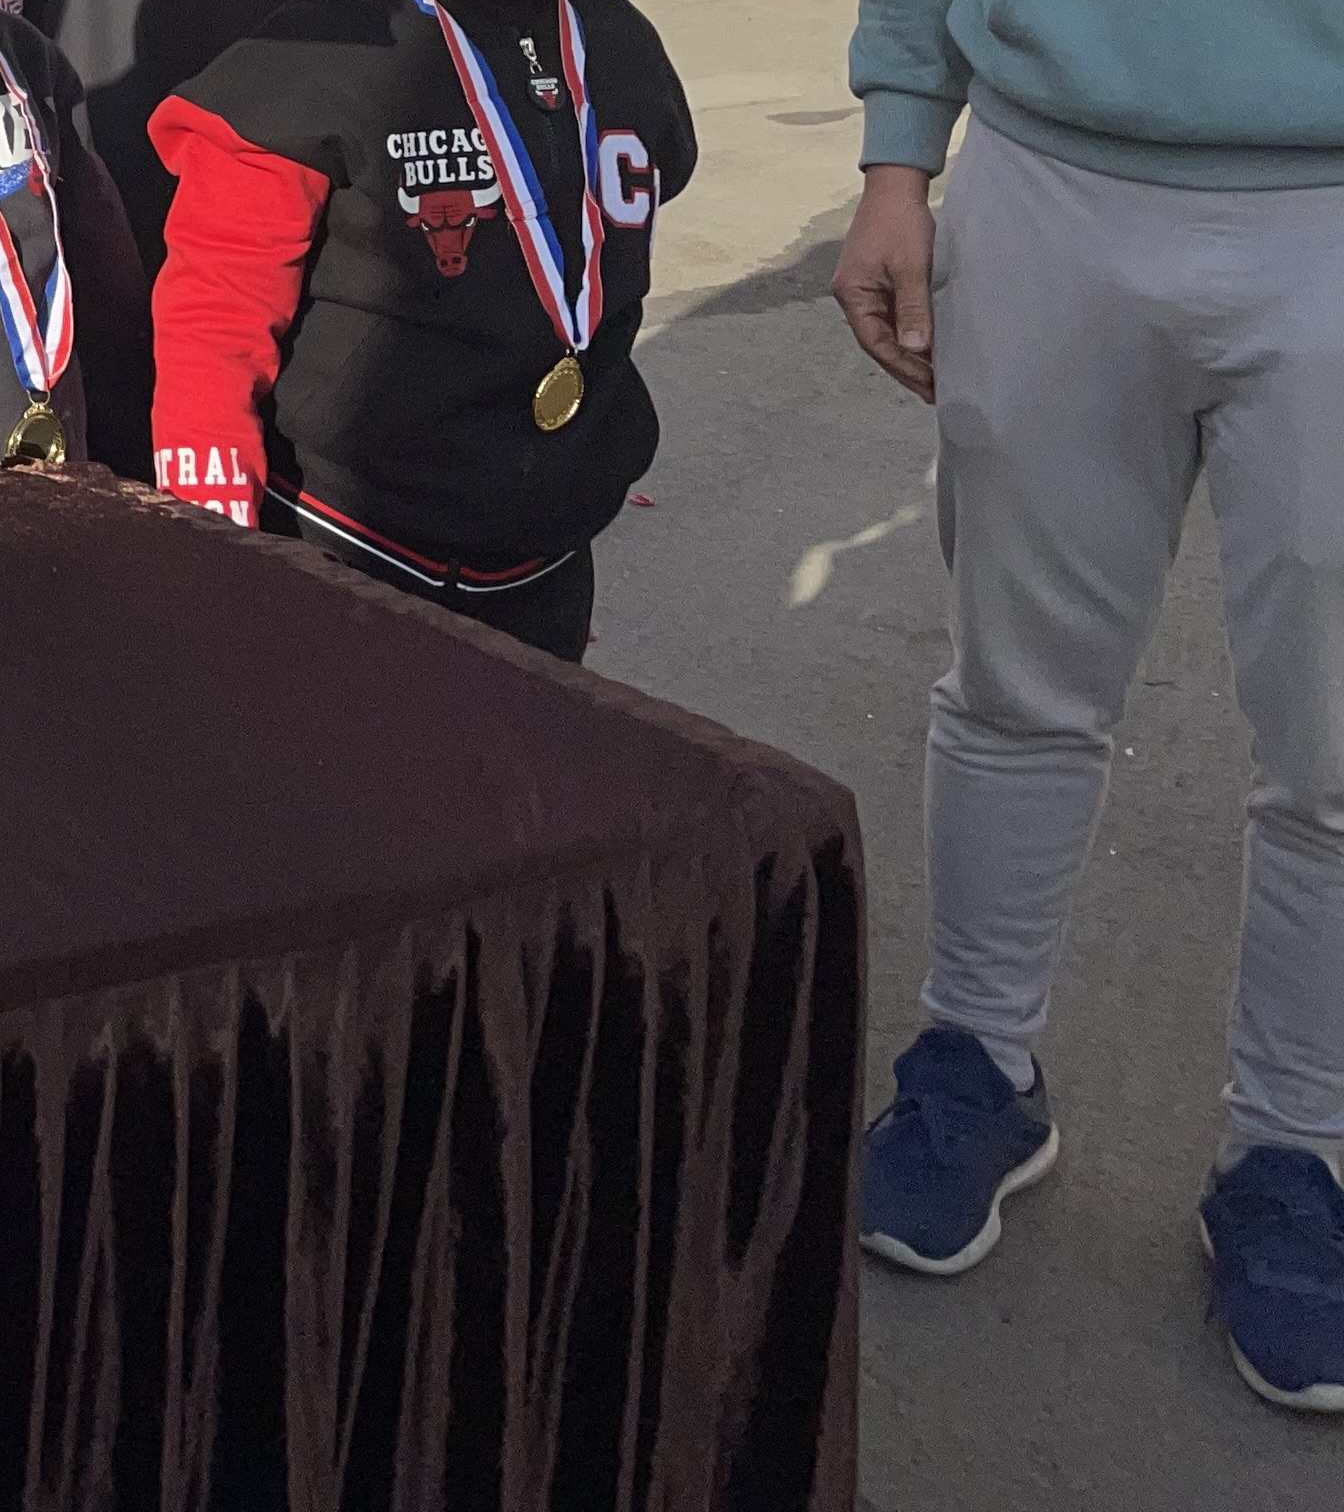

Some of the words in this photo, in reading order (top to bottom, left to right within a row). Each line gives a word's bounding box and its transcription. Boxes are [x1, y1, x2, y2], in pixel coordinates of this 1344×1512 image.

[387, 128, 487, 159] CHICAG
[404, 155, 493, 187] BULLS
[598, 129, 654, 229] C
[154, 446, 247, 490] TRAL
